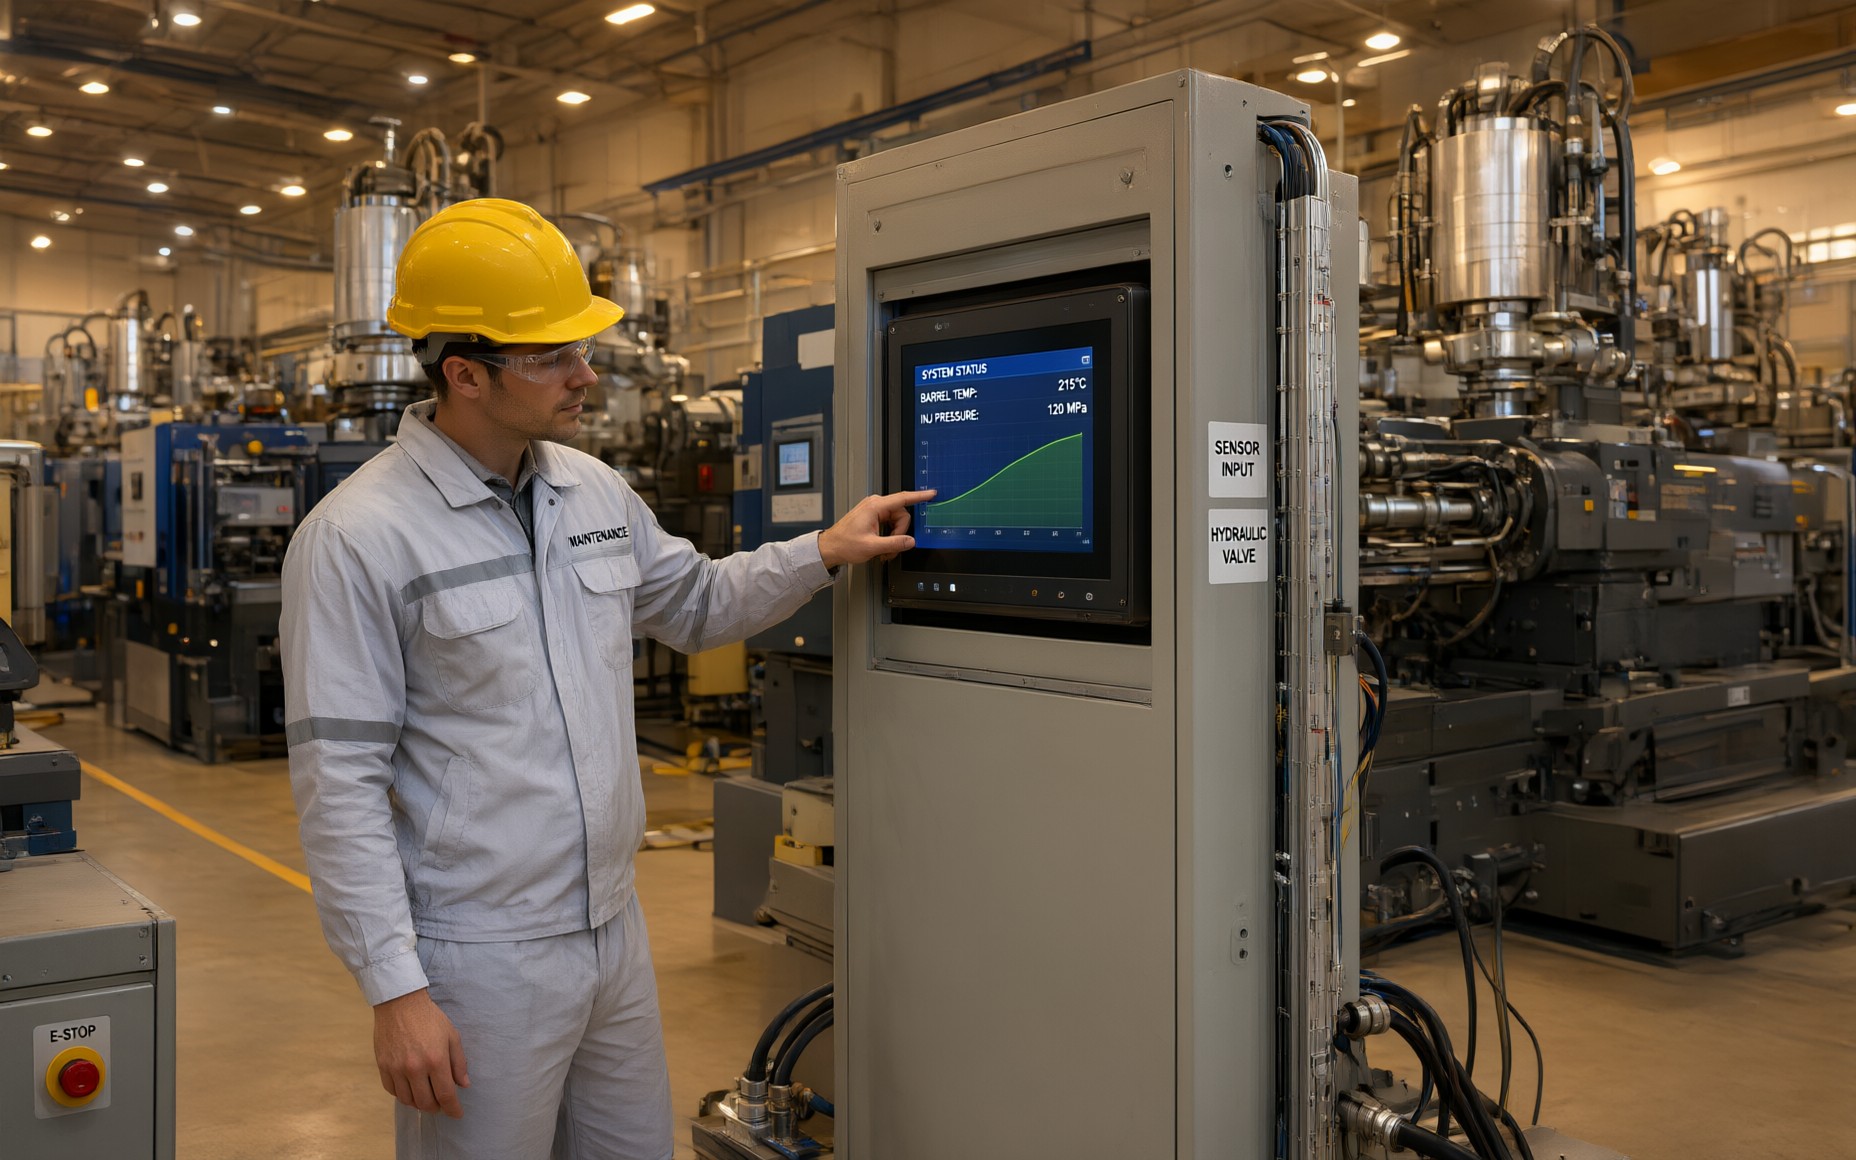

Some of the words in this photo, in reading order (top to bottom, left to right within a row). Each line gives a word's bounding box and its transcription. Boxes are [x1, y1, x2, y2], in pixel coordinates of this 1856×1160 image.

[921, 366, 954, 380] SYSTEM
[955, 363, 988, 376] STATUS
[920, 389, 951, 403] BARREL
[952, 387, 978, 400] TEMP:
[1058, 377, 1087, 391] 215°C
[920, 414, 933, 424] INJ
[934, 409, 979, 423] PRESSURE:
[1047, 403, 1064, 415] 120
[1066, 401, 1088, 414] MPa
[1215, 440, 1260, 455] SENSOR
[1222, 461, 1255, 477] INPUT
[567, 526, 629, 549] MAINTENANCE
[1211, 526, 1267, 542] HYDRAULIC
[1222, 548, 1256, 564] VALVE
[50, 1024, 96, 1043] E-STOP
